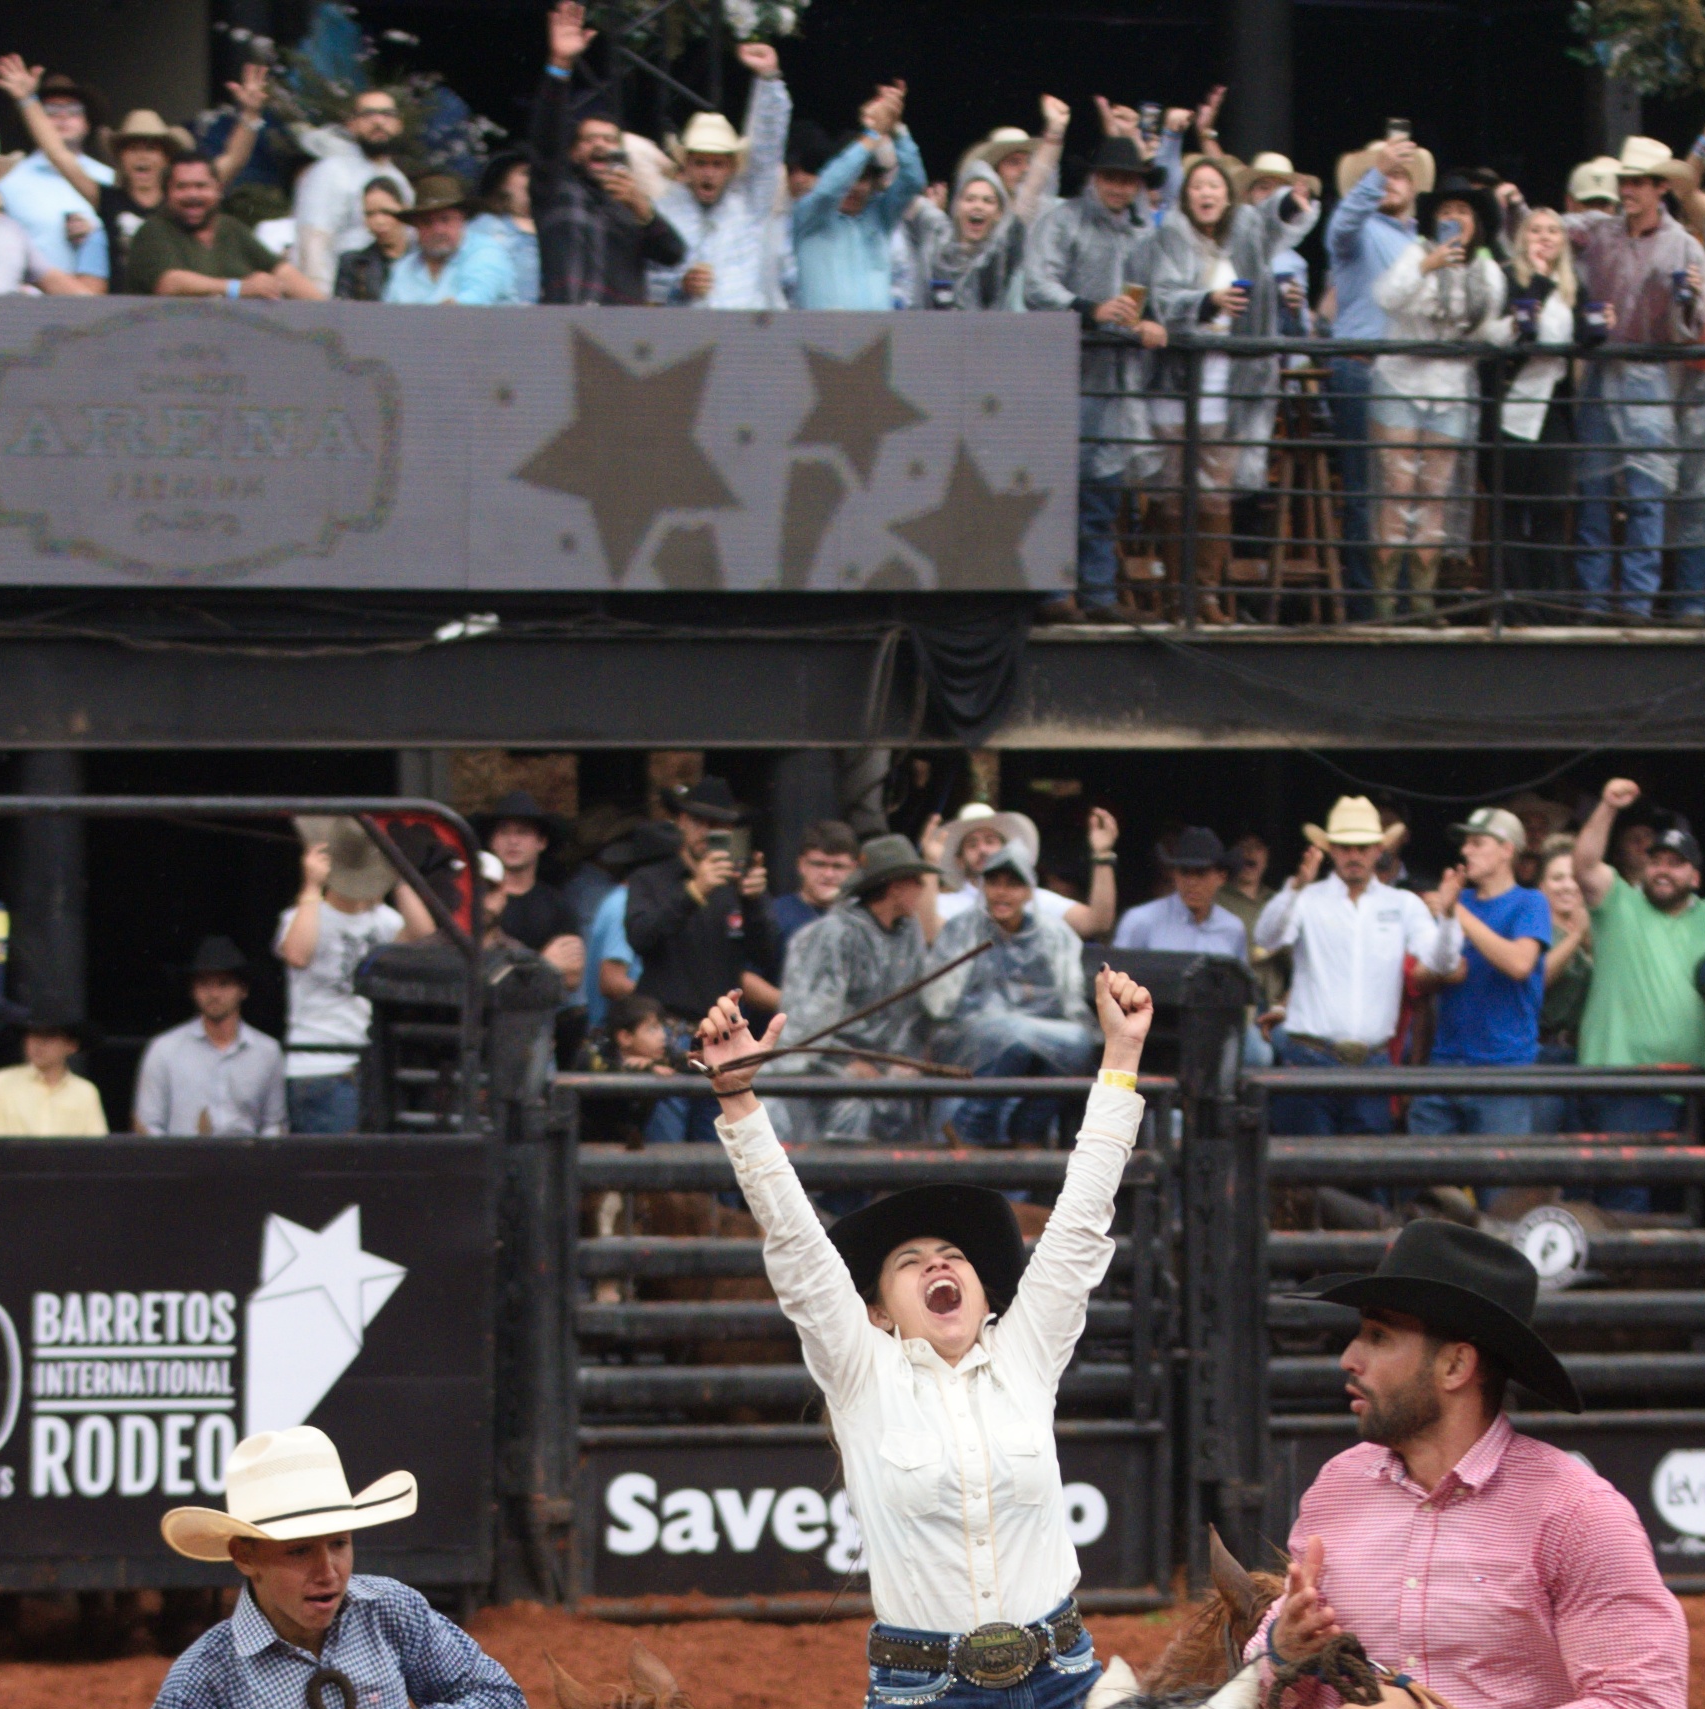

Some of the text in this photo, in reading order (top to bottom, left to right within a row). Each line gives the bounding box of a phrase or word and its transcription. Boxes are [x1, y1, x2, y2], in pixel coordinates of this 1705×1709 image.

[4, 403, 372, 460] ARENA
[32, 1292, 236, 1345] BARRETOS
[32, 1360, 235, 1397] INTERNATIONAL
[31, 1414, 236, 1498] RODEO
